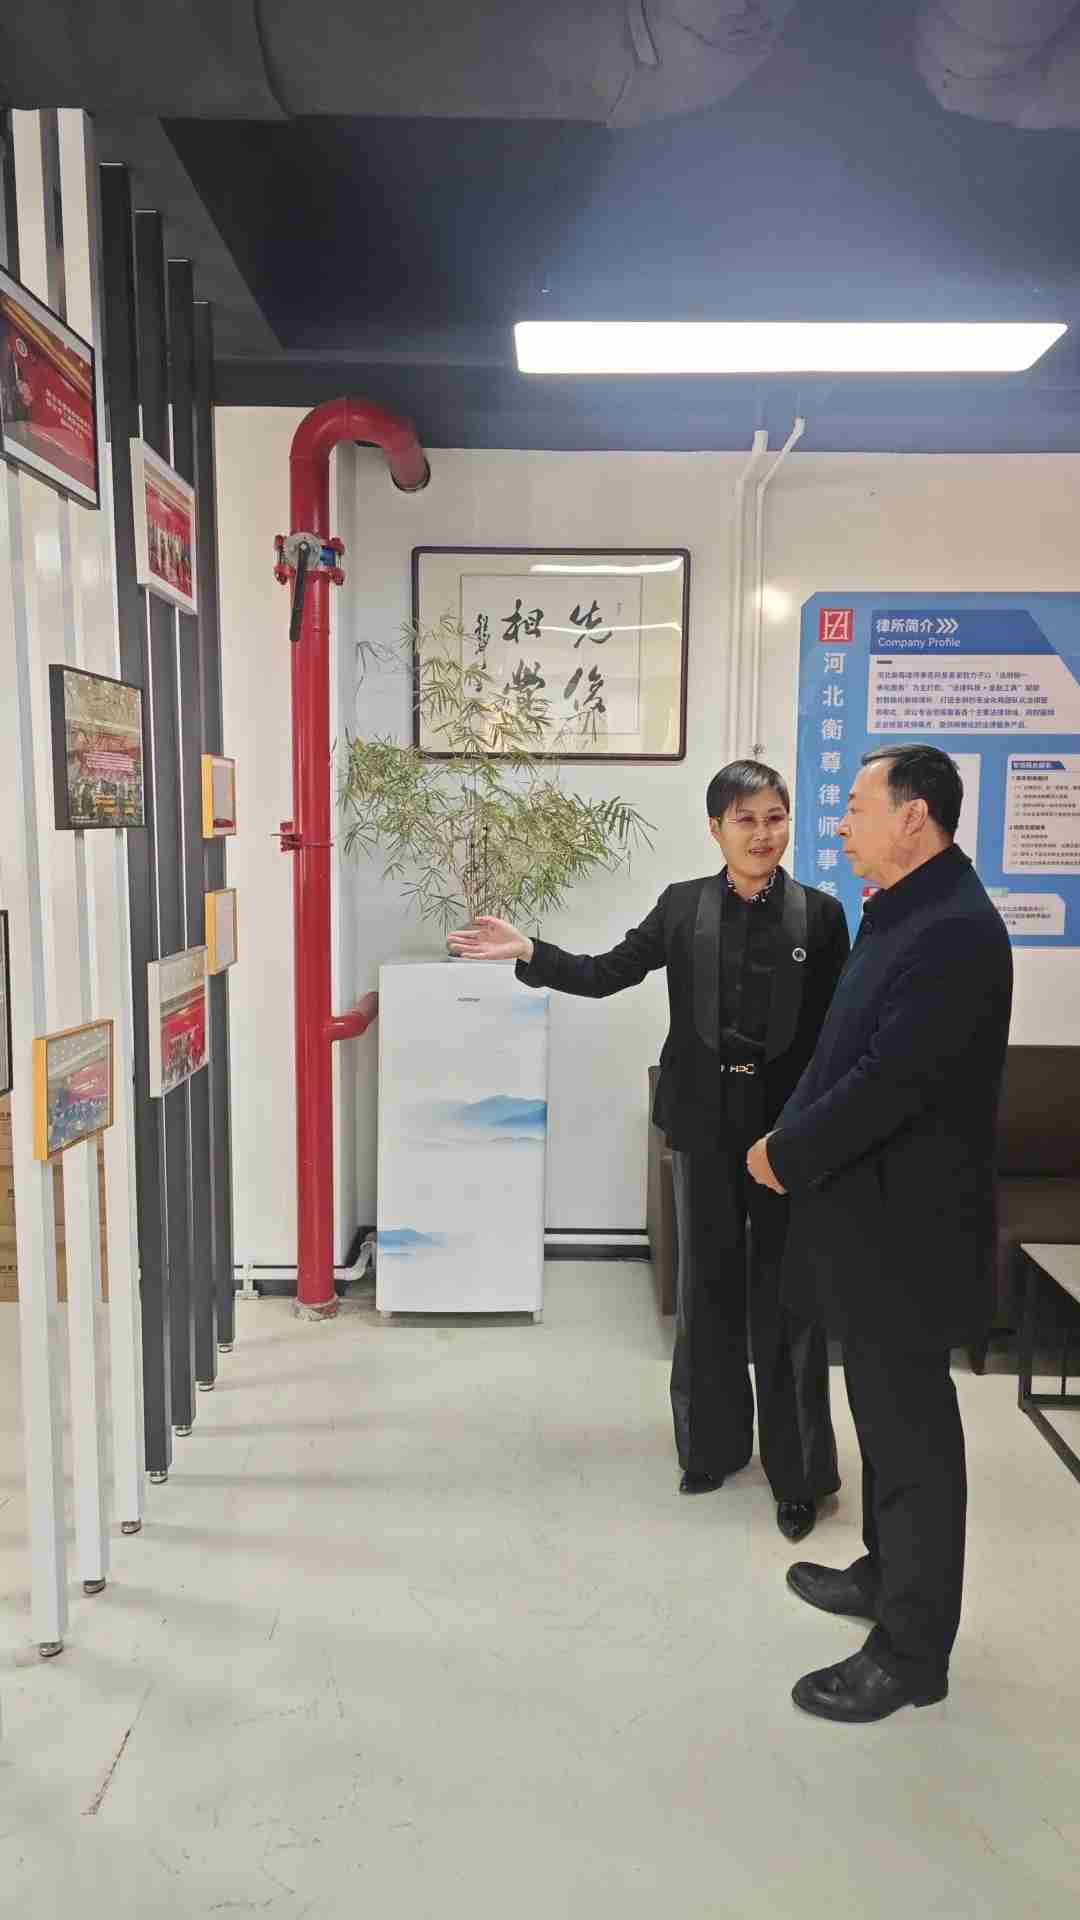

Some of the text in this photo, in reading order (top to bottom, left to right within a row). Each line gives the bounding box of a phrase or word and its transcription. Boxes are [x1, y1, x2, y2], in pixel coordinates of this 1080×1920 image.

[876, 618, 934, 633] 律所简介
[878, 637, 961, 648] Company Profile
